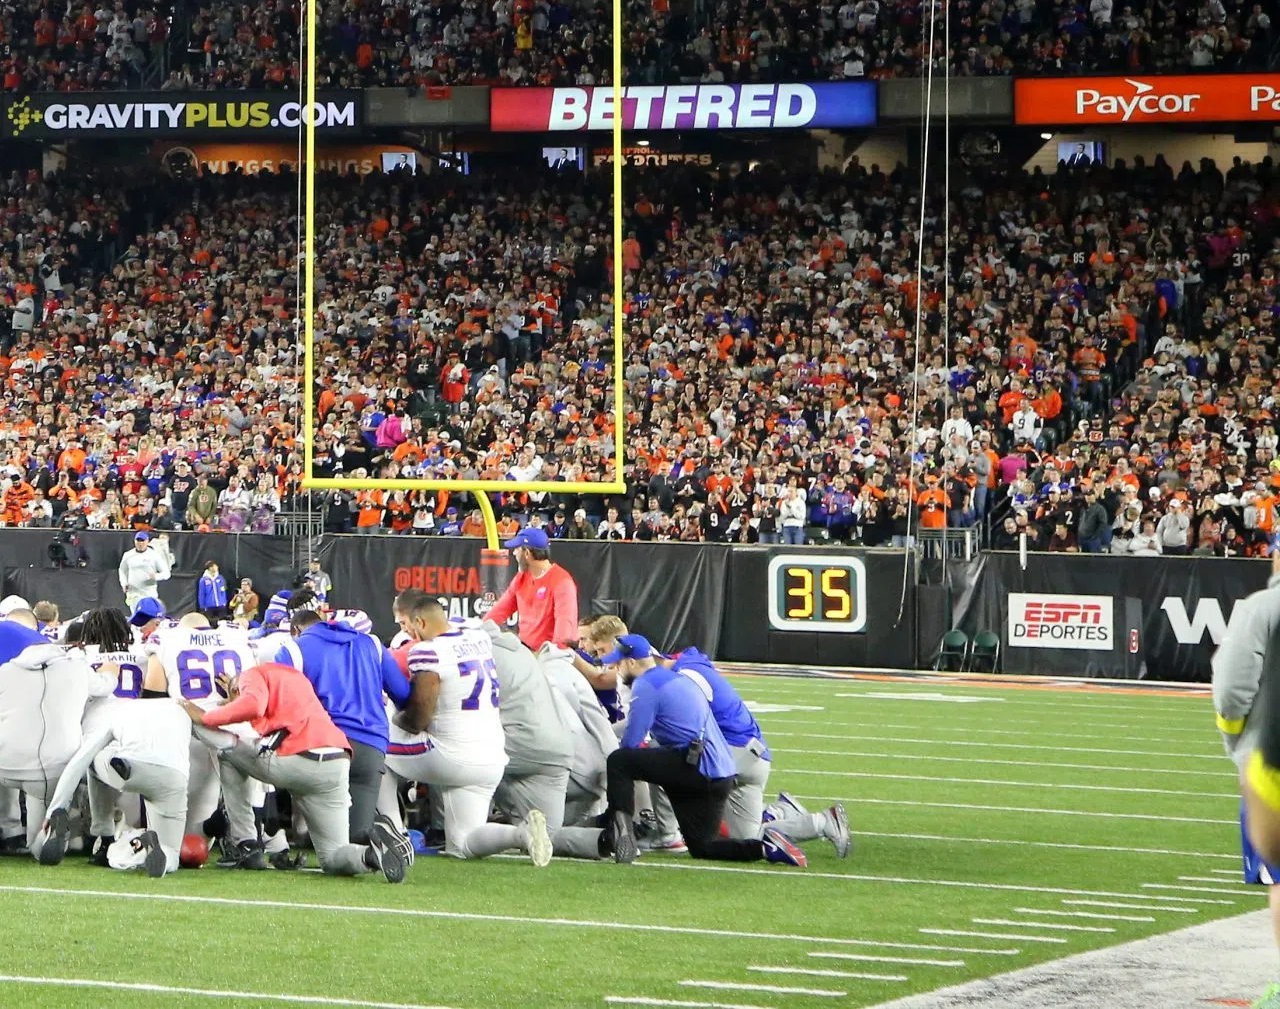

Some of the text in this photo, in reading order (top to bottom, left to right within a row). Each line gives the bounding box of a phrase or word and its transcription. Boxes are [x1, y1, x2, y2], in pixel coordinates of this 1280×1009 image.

[43, 101, 356, 129] GRAVITYPLUS.COM
[547, 82, 817, 130] BETFRED
[1076, 89, 1201, 122] Paycor
[1073, 252, 1084, 263] 85
[1018, 418, 1026, 429] 9
[709, 512, 719, 527] 9
[1064, 510, 1073, 525] 2
[787, 566, 851, 620] 35
[1023, 601, 1102, 625] ESPN
[189, 632, 225, 647] MORSE
[1013, 623, 1108, 641] DEPORTES
[177, 649, 243, 700] 60
